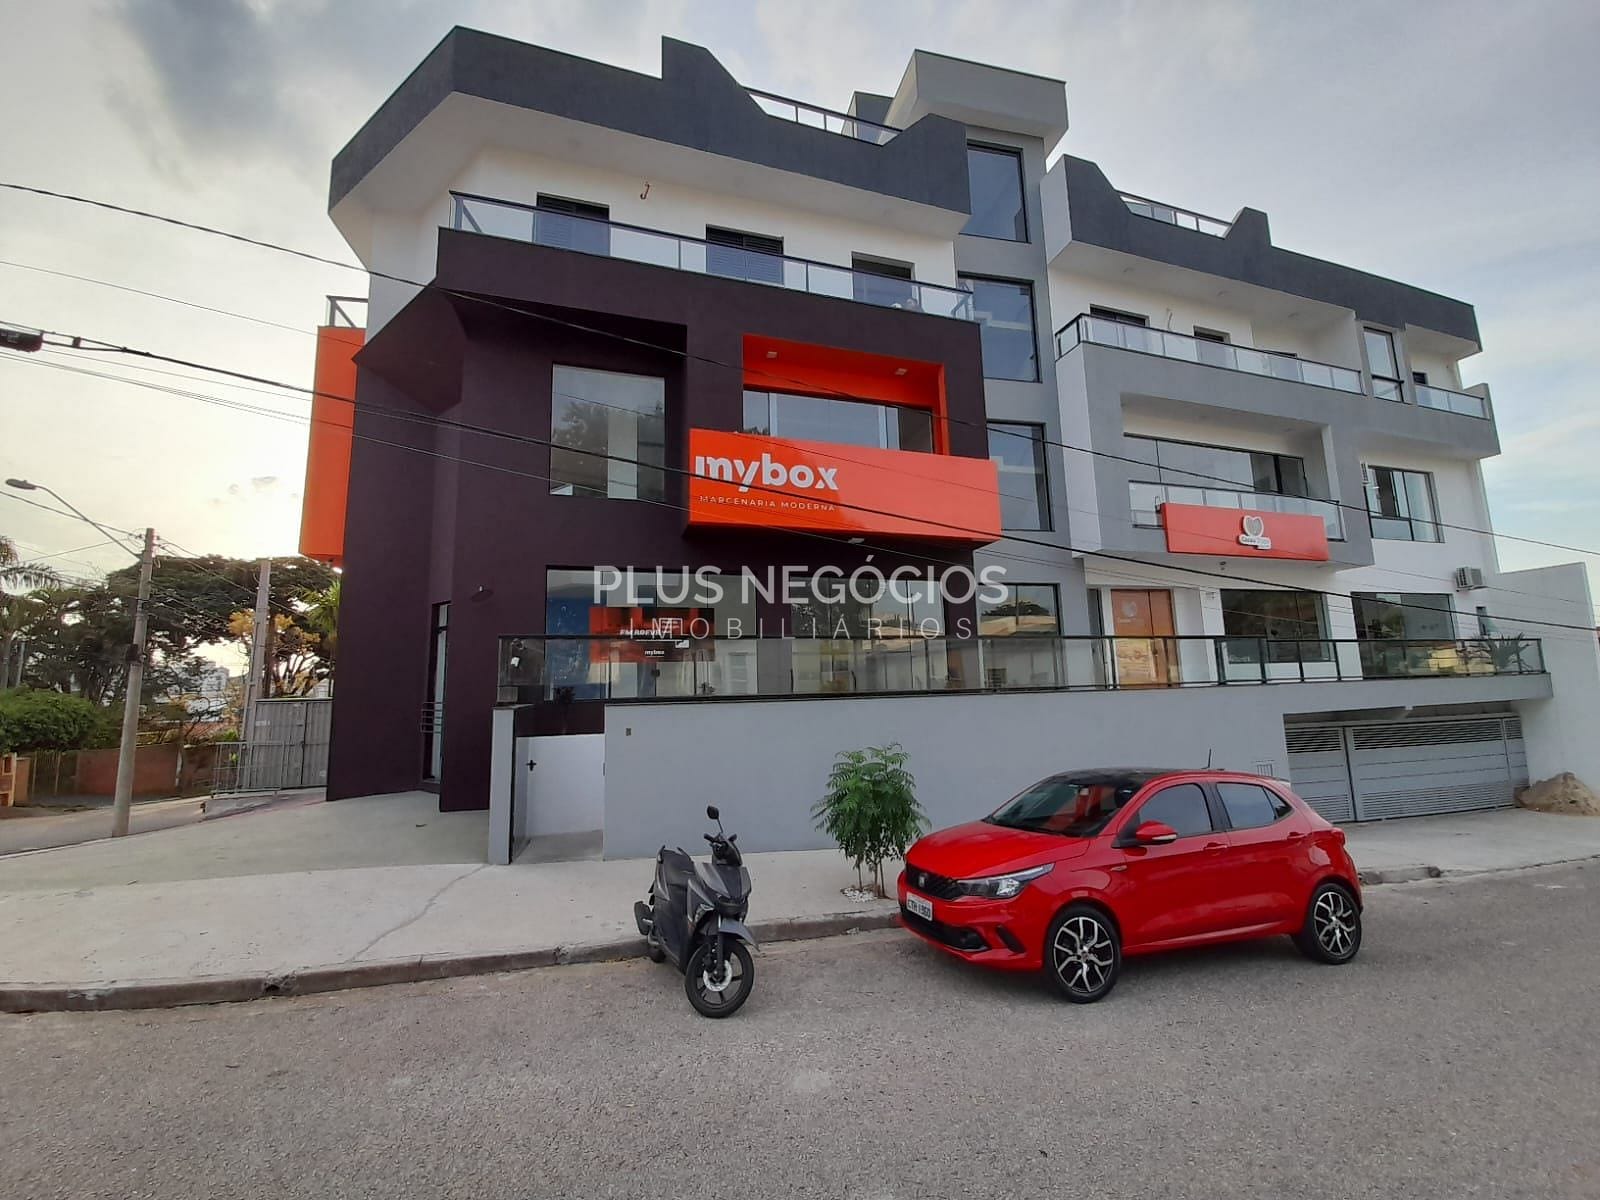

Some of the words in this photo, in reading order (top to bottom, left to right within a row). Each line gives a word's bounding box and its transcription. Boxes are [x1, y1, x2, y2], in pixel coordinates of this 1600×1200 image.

[695, 453, 839, 493] mybox
[699, 495, 776, 508] MARCENARIA
[781, 500, 836, 511] MODERNA
